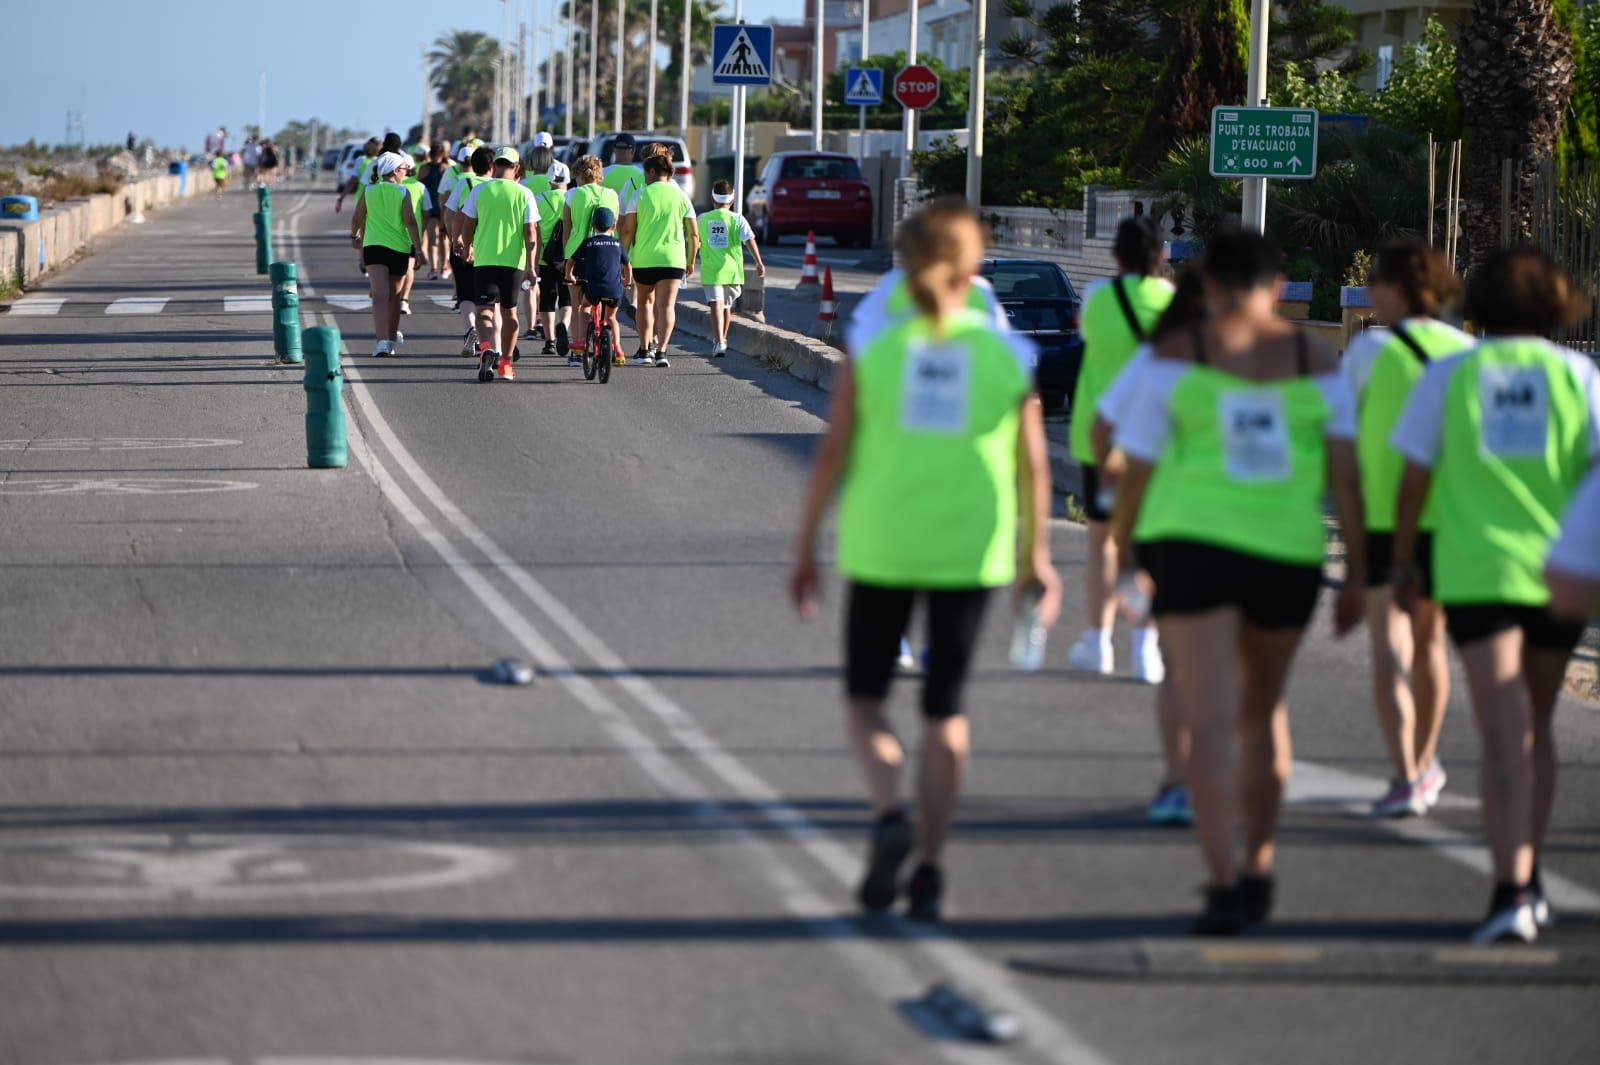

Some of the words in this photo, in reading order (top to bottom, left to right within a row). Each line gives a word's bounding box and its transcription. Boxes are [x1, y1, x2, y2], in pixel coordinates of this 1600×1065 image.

[899, 81, 935, 93] STOP
[1218, 124, 1244, 136] PUNT
[1248, 125, 1261, 137] DE
[1265, 125, 1310, 137] TROBADA
[1231, 138, 1297, 152] D'EVACUACIÓ
[1243, 158, 1268, 168] 600
[1273, 161, 1283, 169] m
